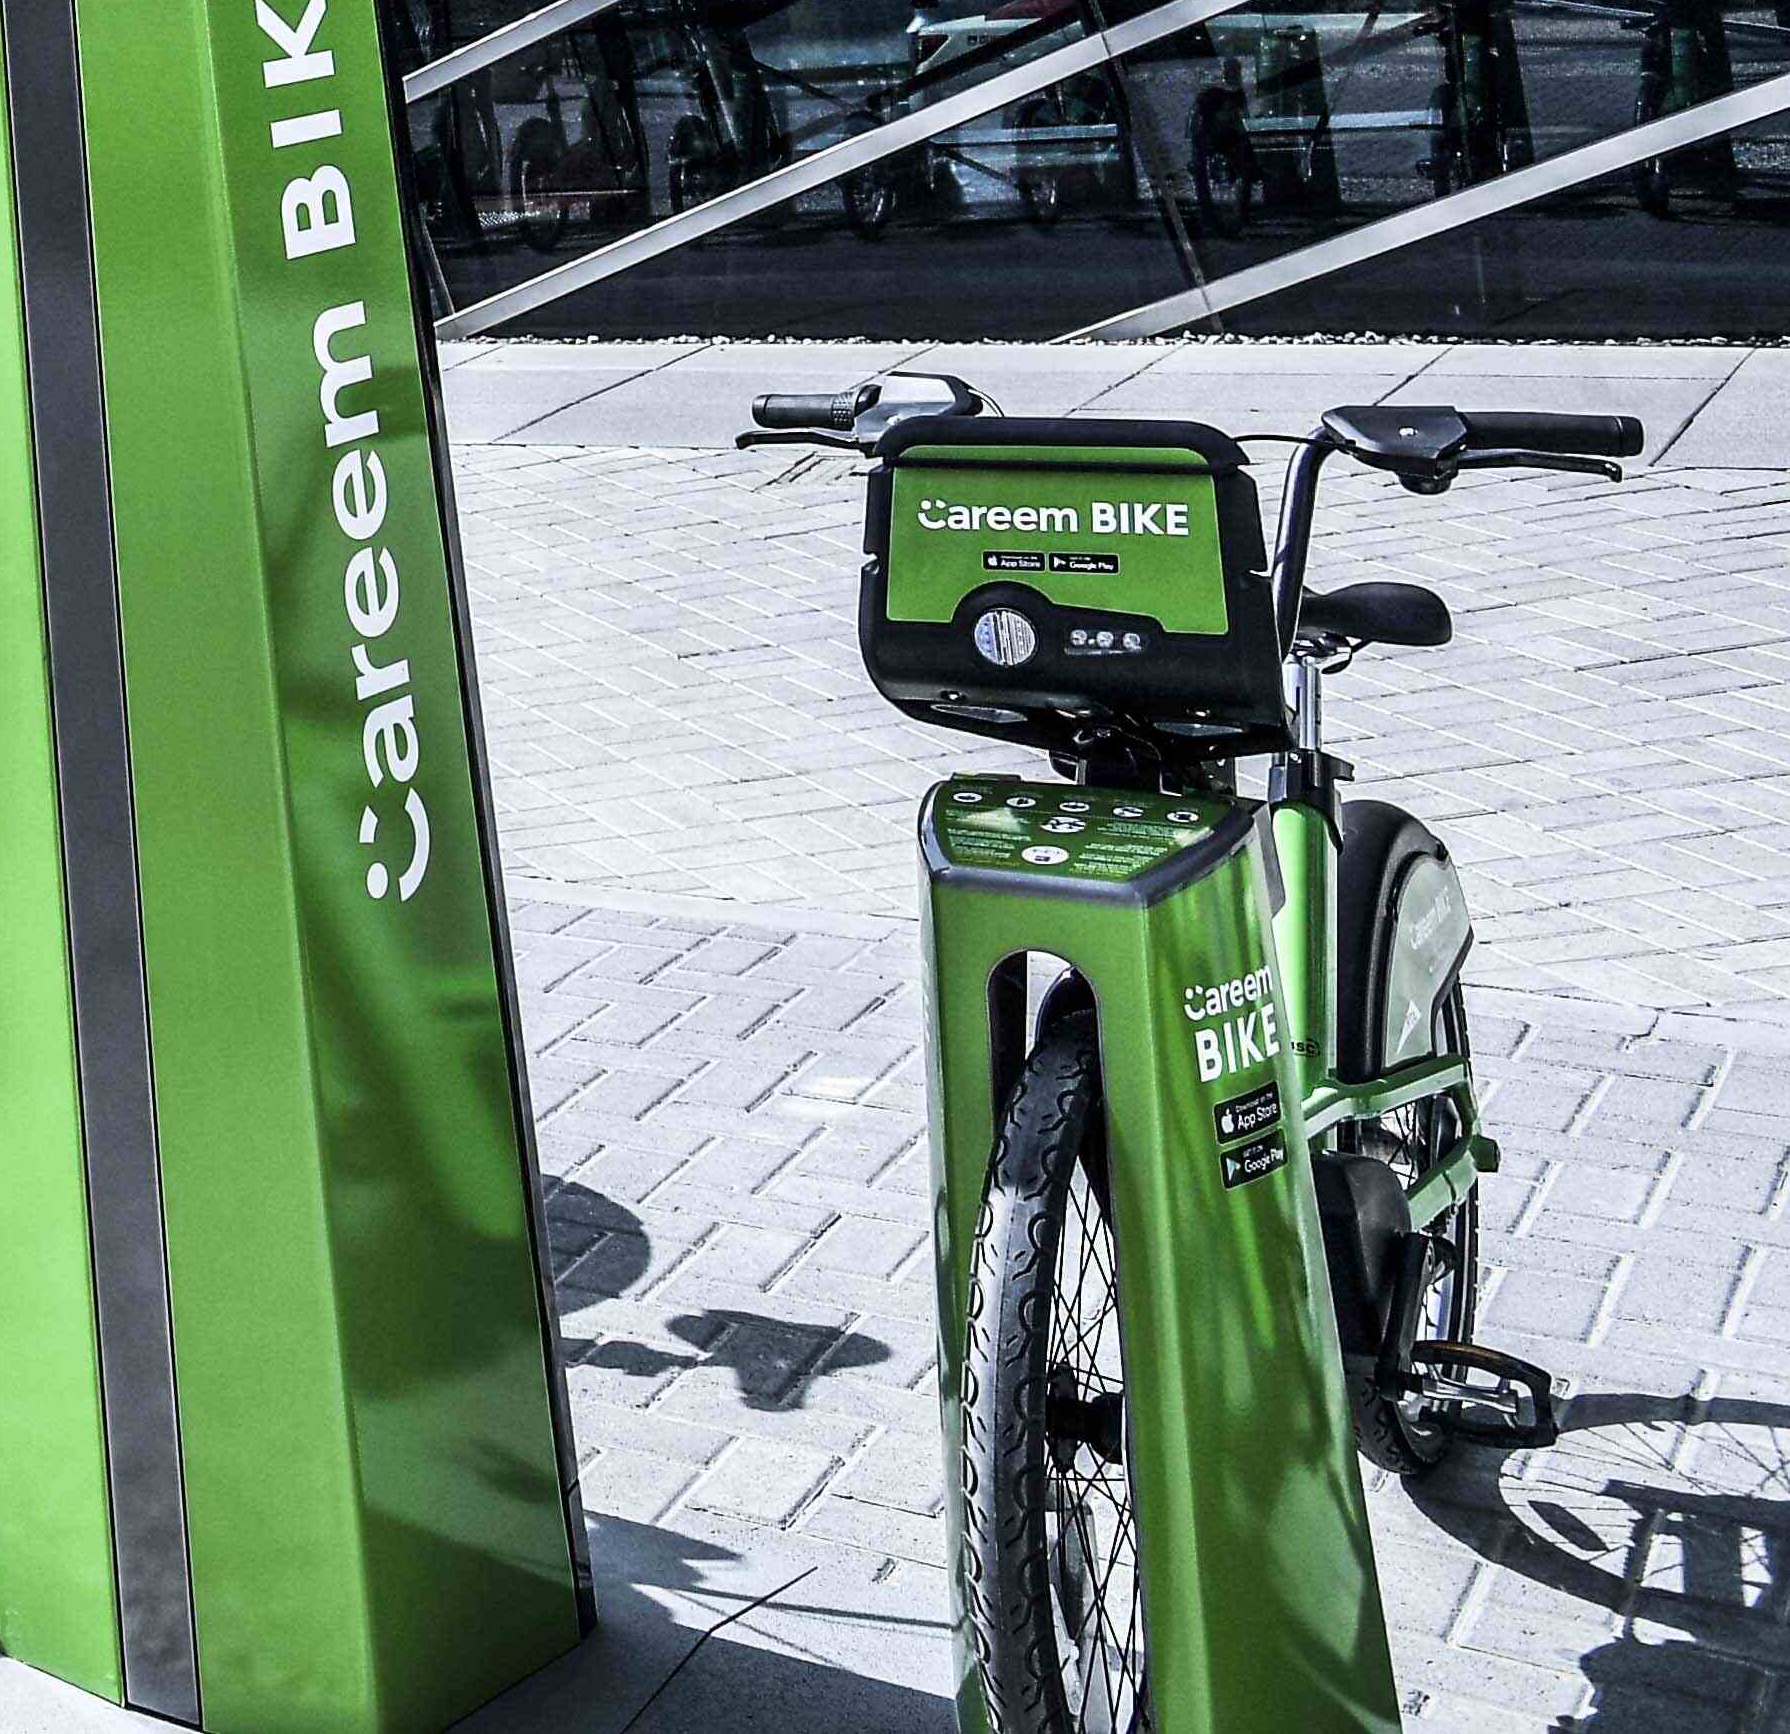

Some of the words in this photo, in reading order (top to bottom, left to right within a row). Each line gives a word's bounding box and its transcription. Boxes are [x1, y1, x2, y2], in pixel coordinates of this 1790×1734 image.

[918, 499, 1078, 532] Careem
[1091, 502, 1189, 535] BIKE
[1001, 559, 1017, 568] App
[1018, 559, 1041, 568] Store
[1069, 561, 1097, 571] Google
[312, 300, 430, 903] Careem
[1184, 966, 1273, 1021] Careem
[1195, 1002, 1280, 1083] BIKE
[1237, 1114, 1256, 1130] App
[1257, 1102, 1277, 1121] Store
[1244, 1152, 1270, 1173] Google
[1270, 1146, 1284, 1164] Play
